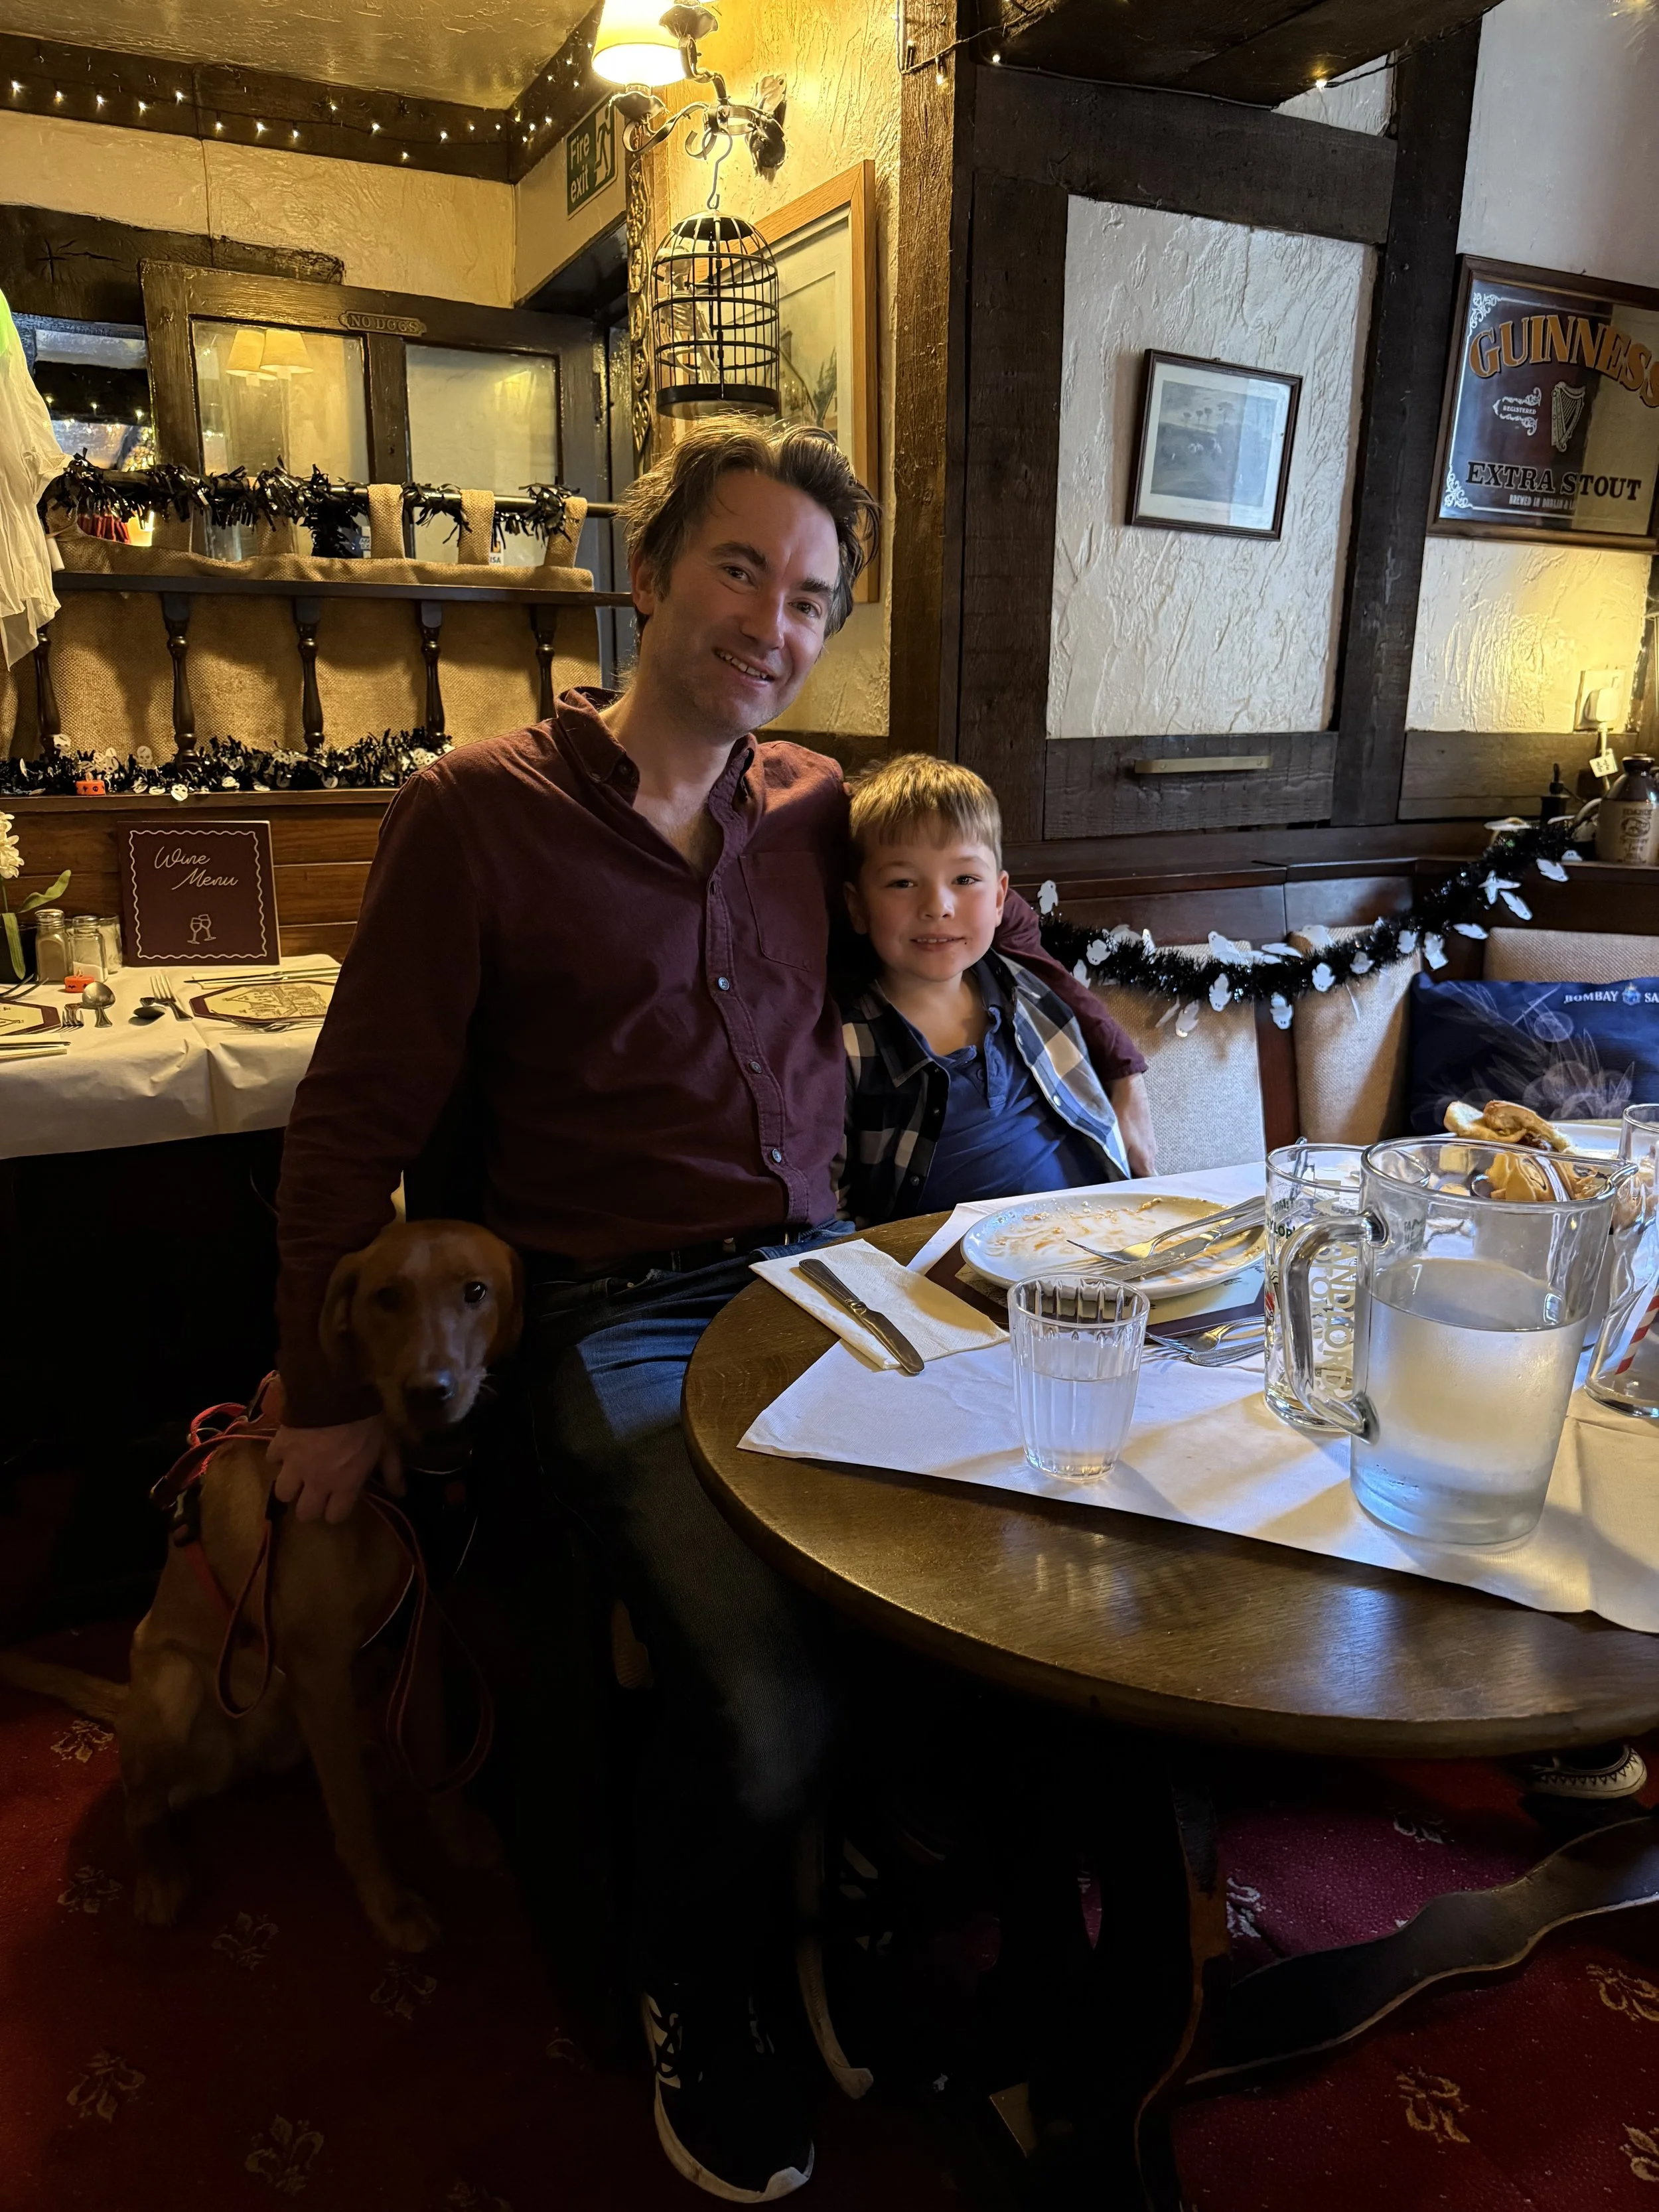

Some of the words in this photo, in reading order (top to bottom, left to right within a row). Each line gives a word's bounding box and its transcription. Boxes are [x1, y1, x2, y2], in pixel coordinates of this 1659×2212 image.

[571, 133, 590, 171] Fire
[570, 164, 589, 204] exit
[350, 315, 371, 328] NO
[376, 318, 417, 332] DOGS
[1502, 405, 1537, 415] REGISTERED
[1465, 461, 1555, 493] EXTRA
[1560, 471, 1642, 501] STOUT
[1509, 494, 1532, 506] BREWED
[154, 846, 211, 869] Wine
[171, 867, 239, 891] Menu
[1563, 990, 1619, 1004] BOMBAY
[1321, 1240, 1358, 1394] ANDLORD
